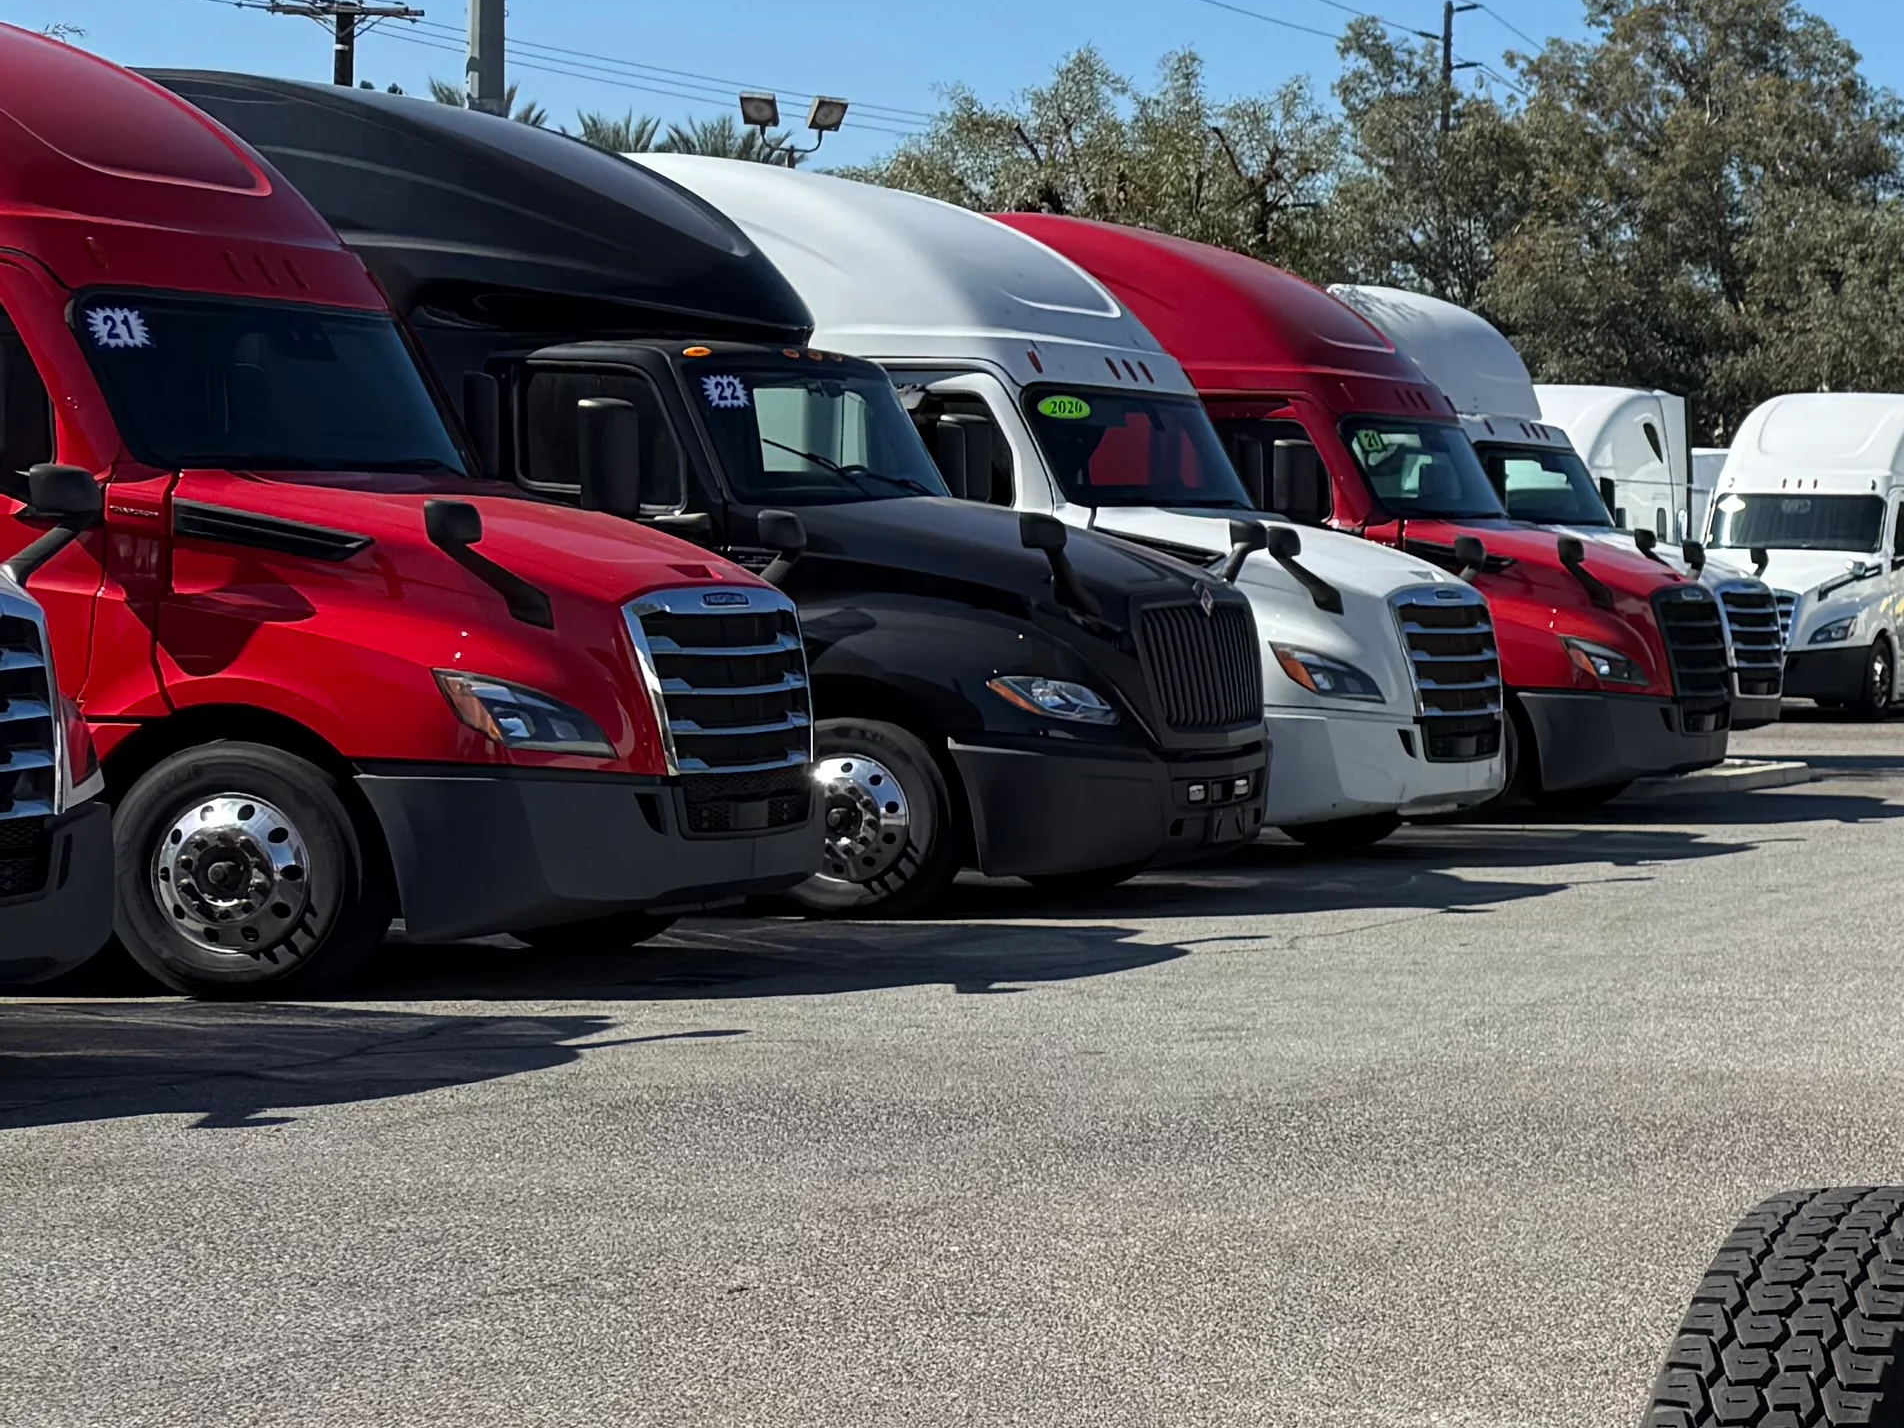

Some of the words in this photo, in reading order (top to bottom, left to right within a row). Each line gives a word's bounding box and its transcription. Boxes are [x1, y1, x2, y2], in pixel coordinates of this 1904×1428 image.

[102, 314, 136, 340] 21
[714, 380, 741, 401] 22
[1050, 400, 1083, 414] 2020
